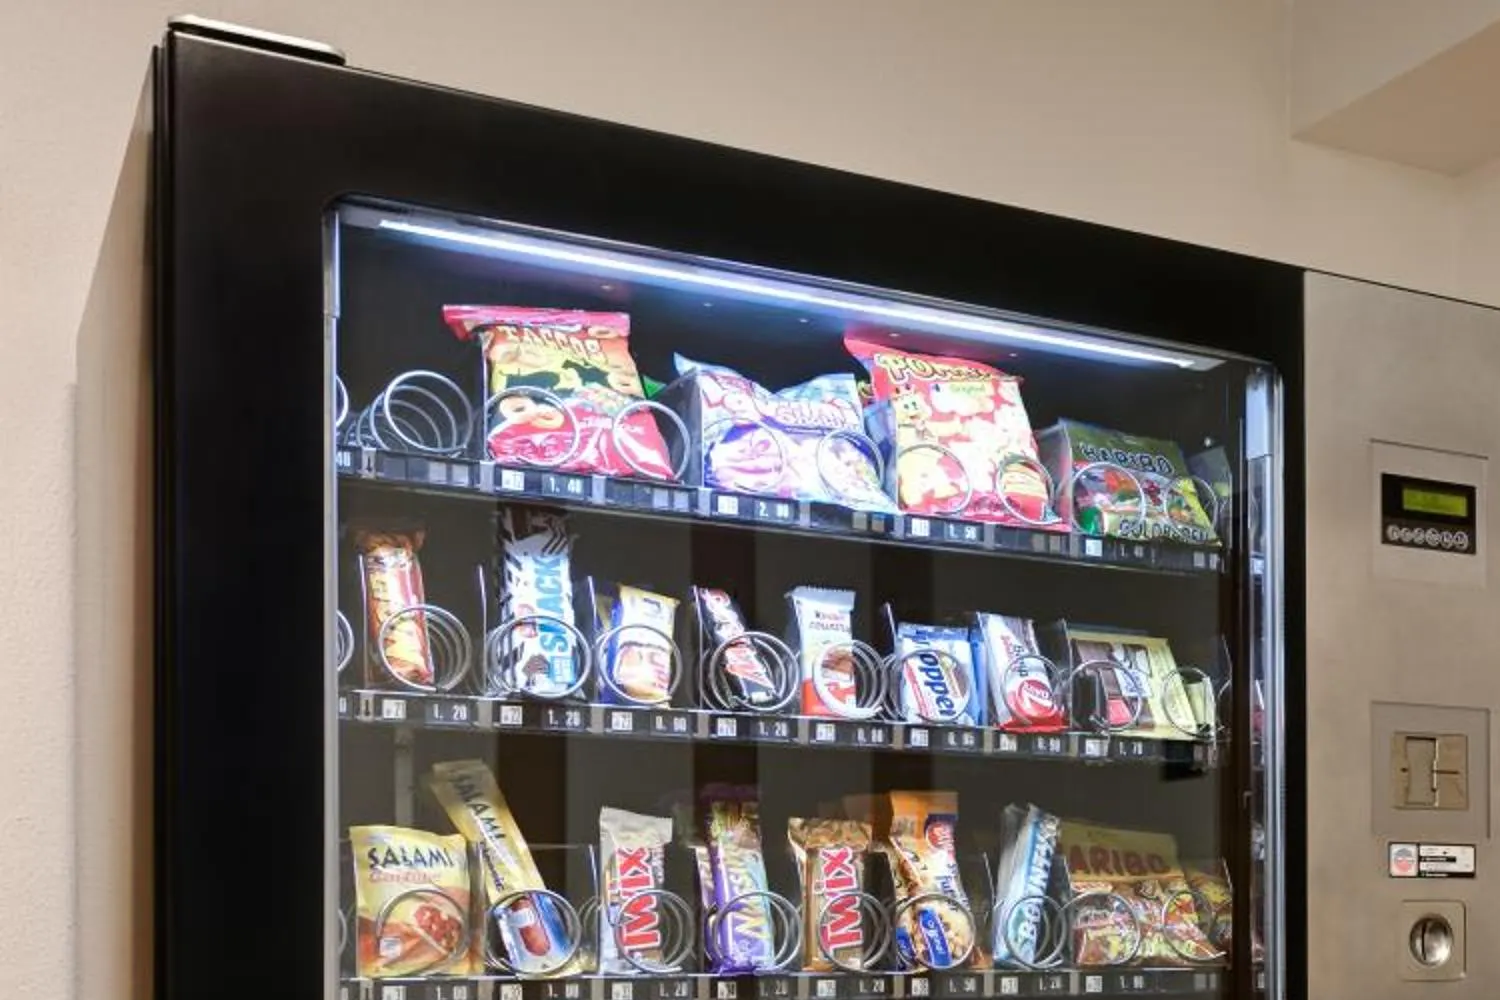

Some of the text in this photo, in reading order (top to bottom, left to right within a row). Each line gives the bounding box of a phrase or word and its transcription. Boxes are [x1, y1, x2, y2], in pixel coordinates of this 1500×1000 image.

[1080, 442, 1175, 475] HARIBO
[532, 554, 568, 653] SNACK
[449, 767, 506, 842] SALAMI
[367, 846, 455, 870] SALAMI
[1057, 843, 1171, 877] ARIBO
[609, 846, 662, 955] Twix
[814, 846, 864, 952] Twix
